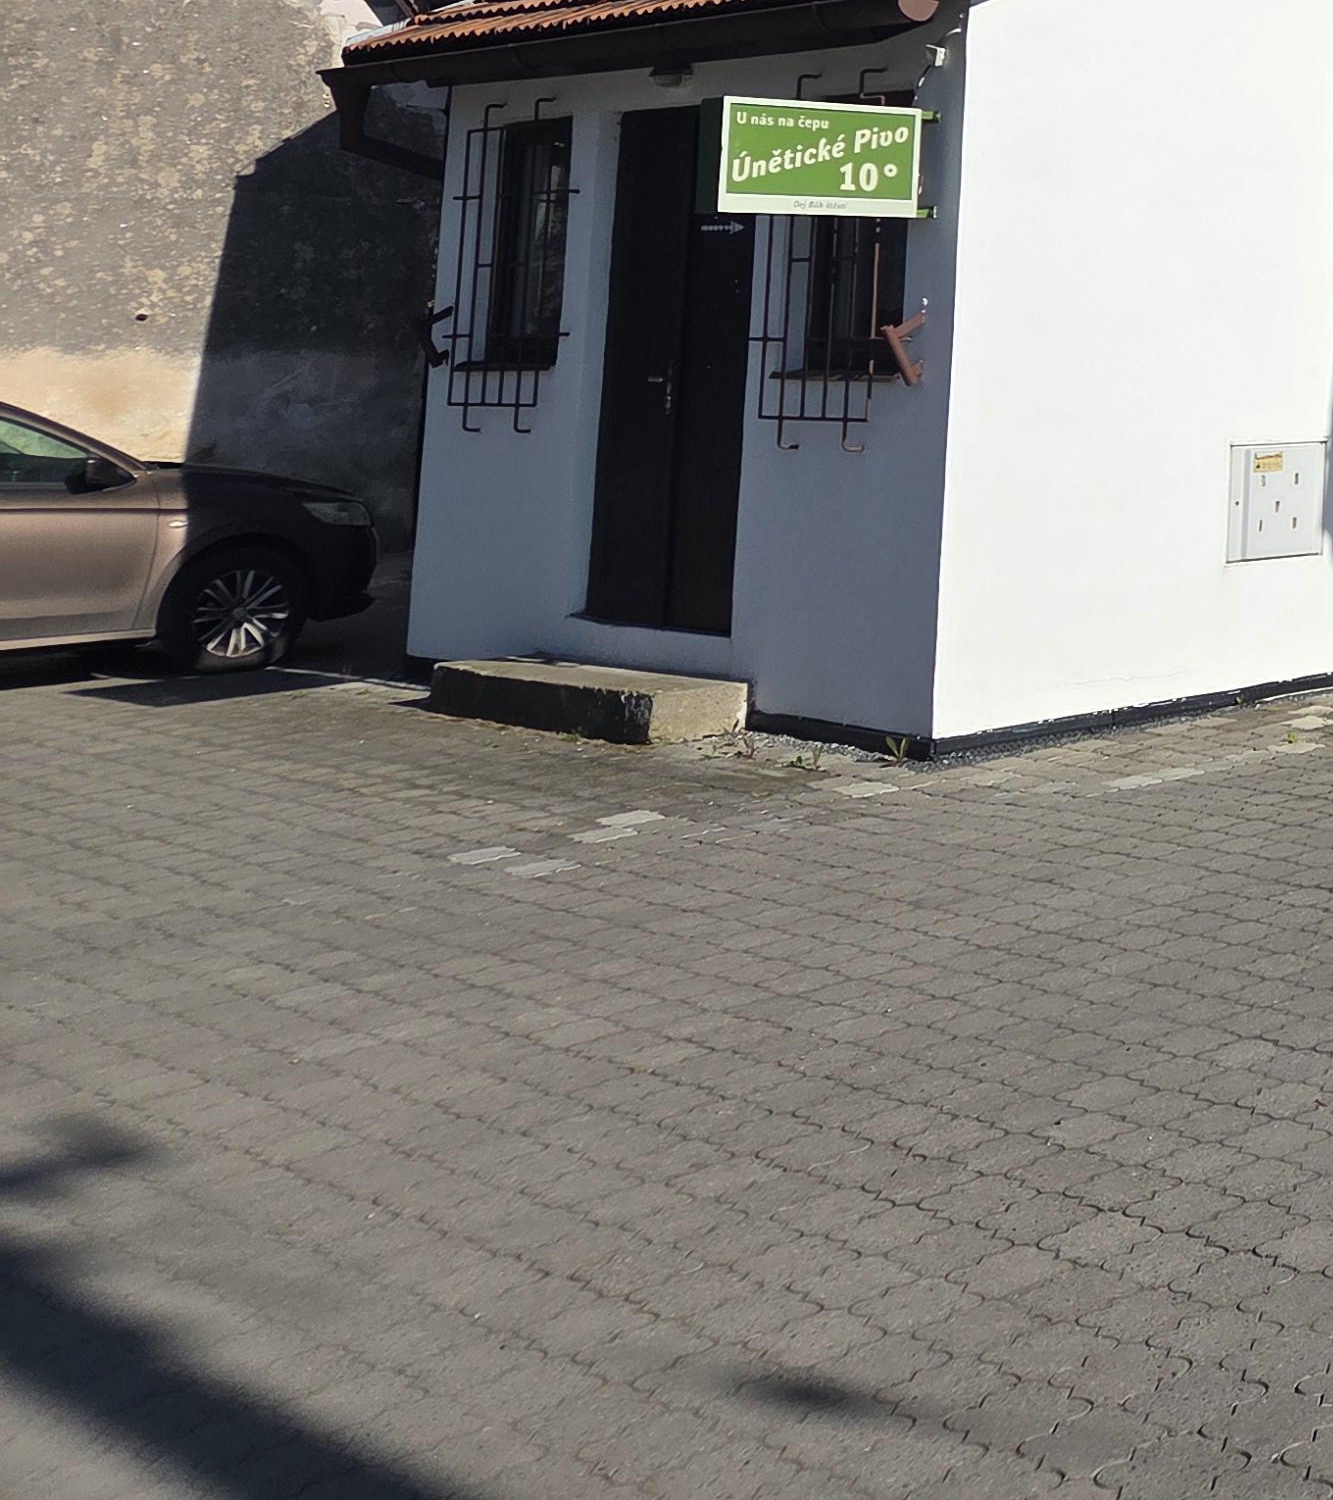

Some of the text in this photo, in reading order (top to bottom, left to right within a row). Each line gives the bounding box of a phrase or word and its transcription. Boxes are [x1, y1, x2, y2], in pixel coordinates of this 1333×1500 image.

[736, 111, 829, 131] U nás na čepu
[731, 127, 909, 182] Únětické Pivo
[840, 162, 898, 192] 10°
